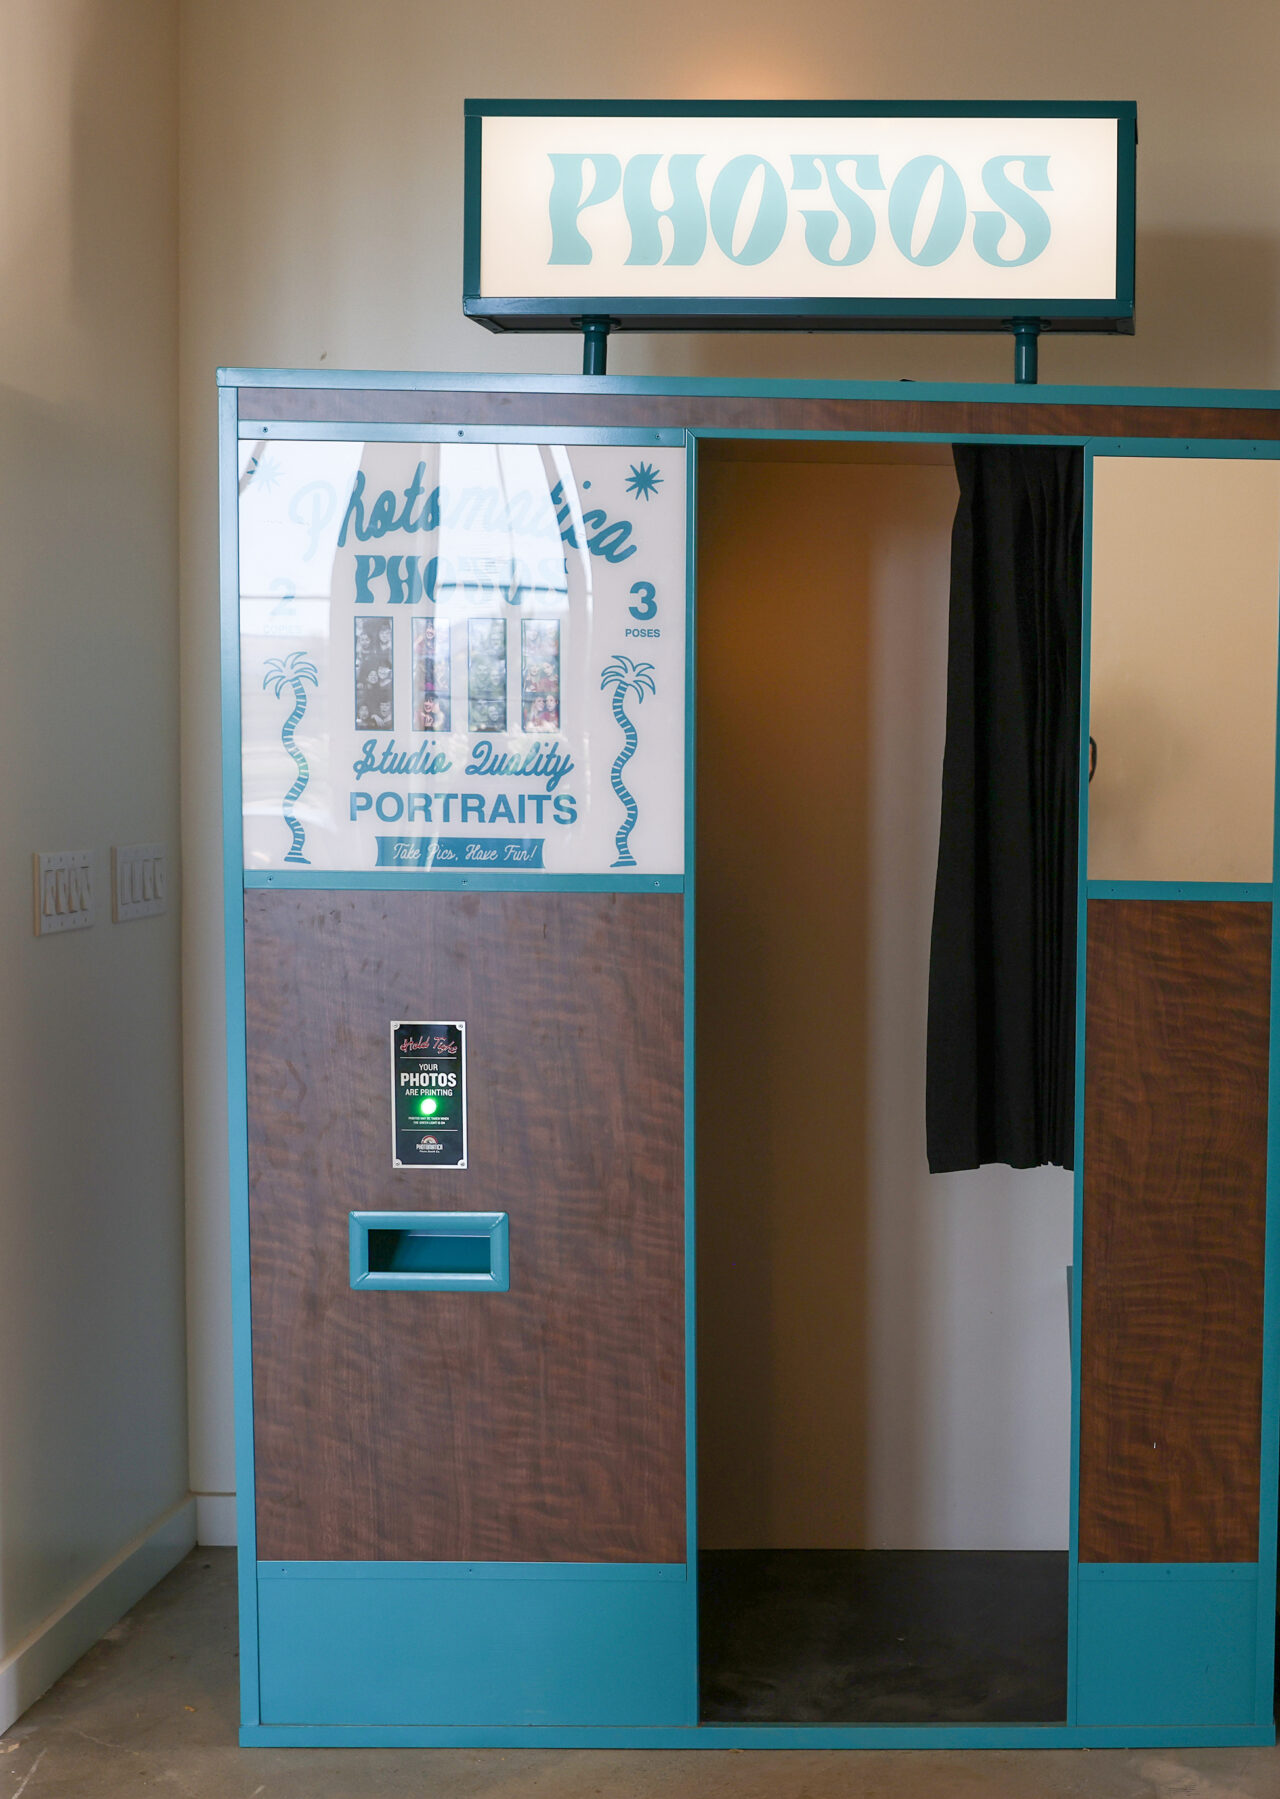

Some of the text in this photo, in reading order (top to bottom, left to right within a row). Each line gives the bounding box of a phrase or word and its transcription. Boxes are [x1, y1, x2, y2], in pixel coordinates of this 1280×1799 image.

[546, 153, 1054, 267] PHOTOS
[288, 460, 637, 565] Photomatica
[269, 576, 297, 617] 2
[354, 554, 569, 606] PHOTOS
[628, 581, 658, 621] 3
[625, 628, 661, 638] POSES
[353, 738, 575, 792] Studio Quality
[350, 791, 578, 825] PORTRAITS
[393, 842, 538, 862] Take Pics, Have Fun!
[400, 1036, 430, 1053] Hold
[400, 1072, 457, 1088] PHOTOS
[419, 1063, 438, 1071] YOUR
